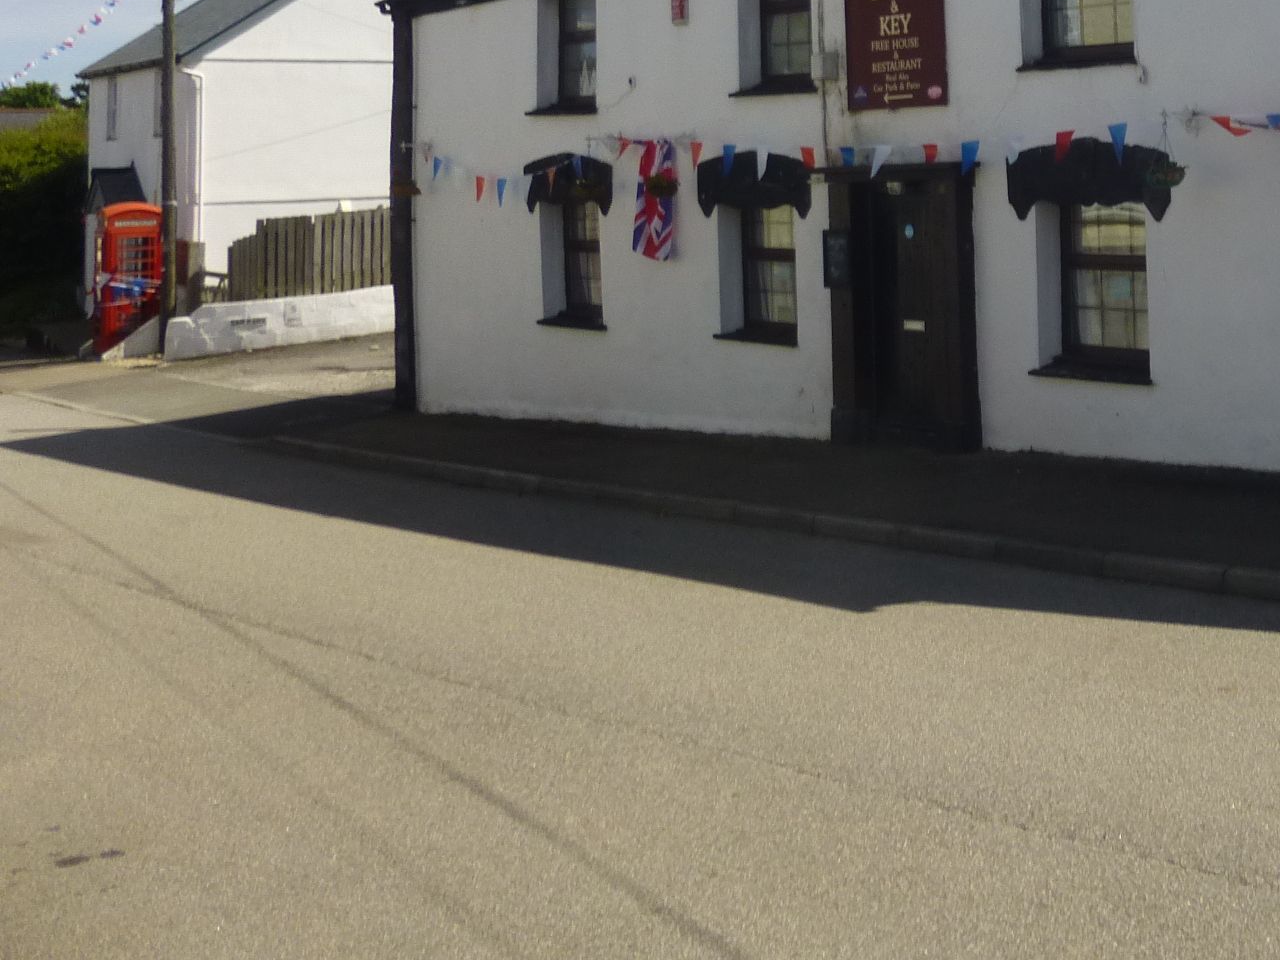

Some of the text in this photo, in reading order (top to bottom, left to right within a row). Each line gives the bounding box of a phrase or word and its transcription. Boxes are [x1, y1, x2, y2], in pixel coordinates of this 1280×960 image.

[890, 0, 899, 13] &
[880, 13, 911, 35] KEY
[871, 37, 919, 52] FREE HOUSE
[872, 58, 922, 73] RESTAURANT
